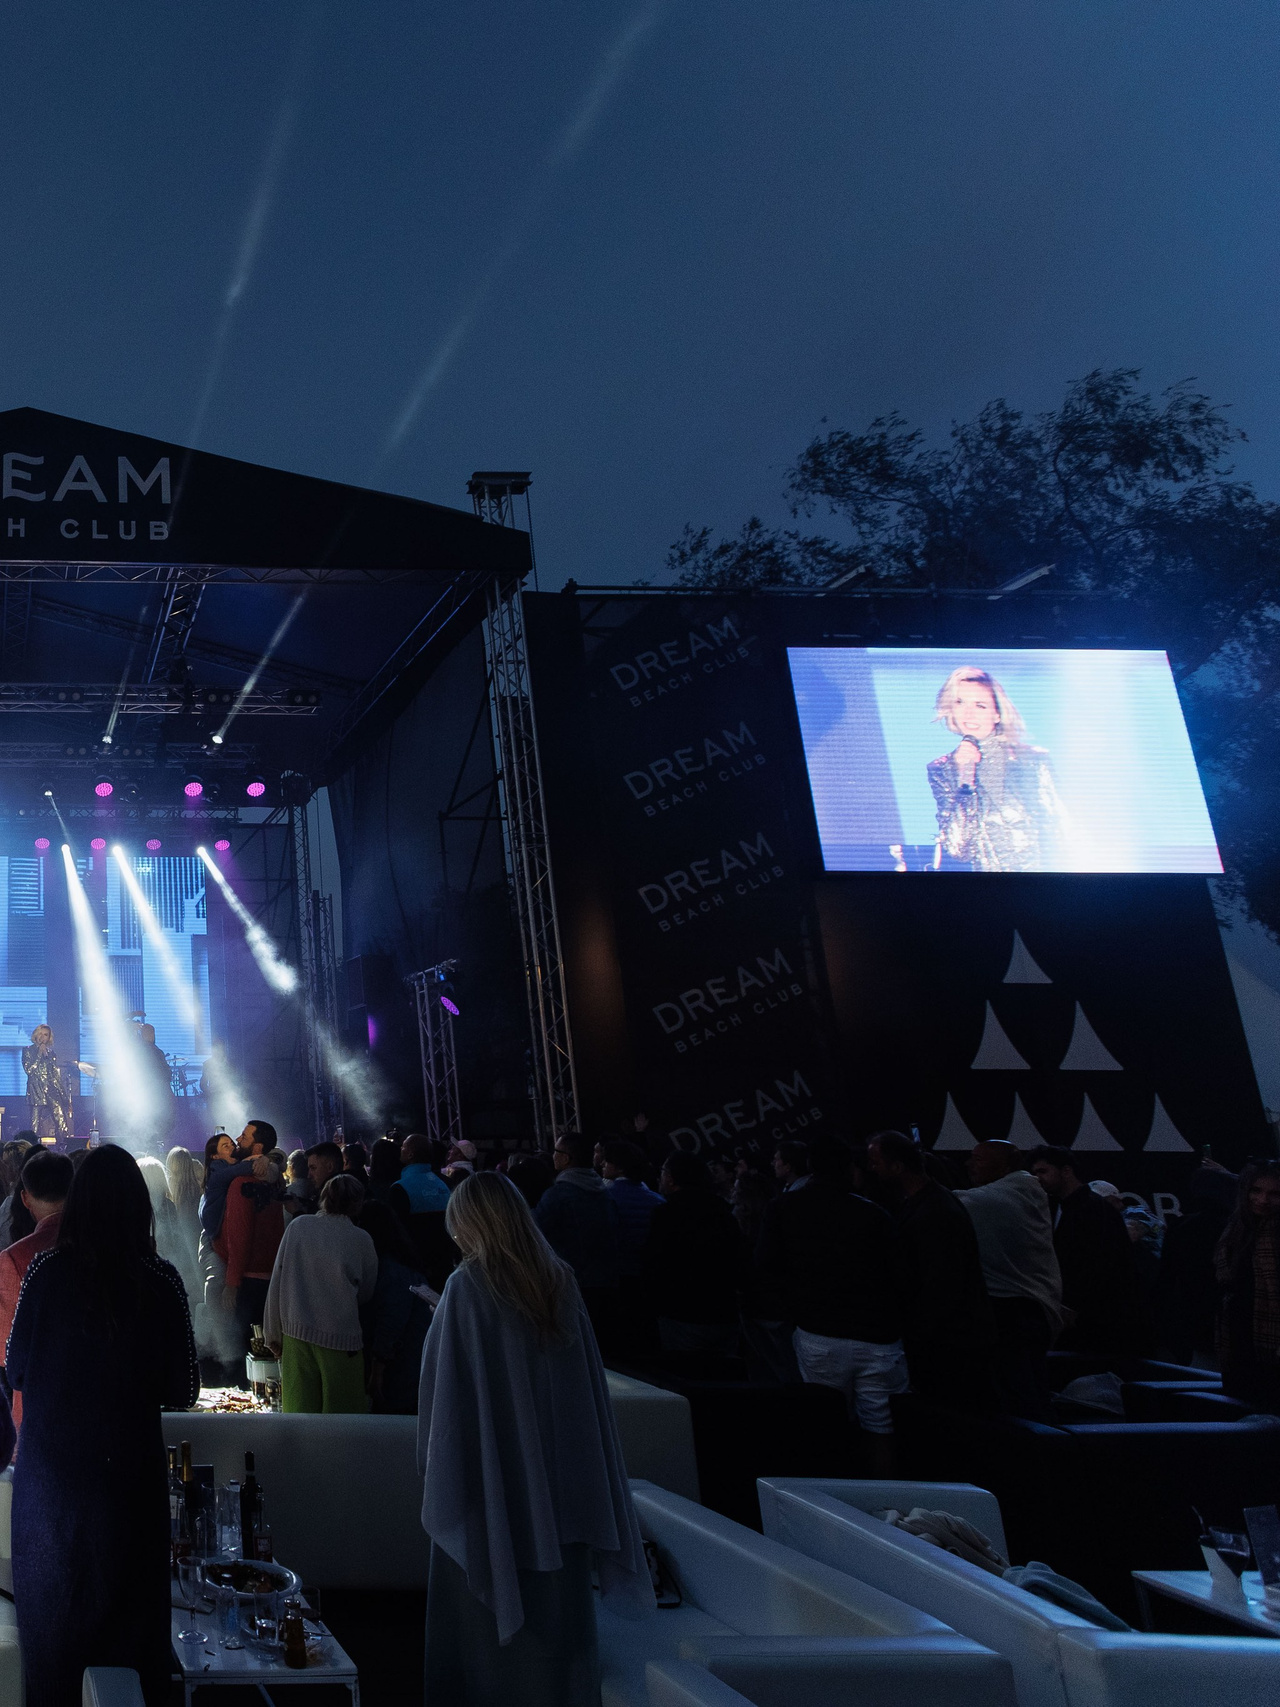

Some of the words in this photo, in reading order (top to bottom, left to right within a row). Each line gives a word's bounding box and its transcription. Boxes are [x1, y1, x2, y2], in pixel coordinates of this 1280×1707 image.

[59, 518, 170, 540] CLUB
[609, 615, 740, 691] DREAM
[628, 671, 693, 708] BEACH
[702, 646, 750, 674] CLUB
[622, 720, 758, 800] DREAM
[643, 780, 708, 818] BEACH
[718, 753, 766, 782] CLUB
[636, 831, 775, 915] DREAM
[657, 893, 725, 933] BEACH
[735, 865, 785, 896] CLUB
[651, 947, 793, 1035] DREAM
[673, 1013, 743, 1054] BEACH
[753, 983, 804, 1015] CLUB
[668, 1069, 813, 1155] DREAM
[771, 1106, 823, 1140] CLUB
